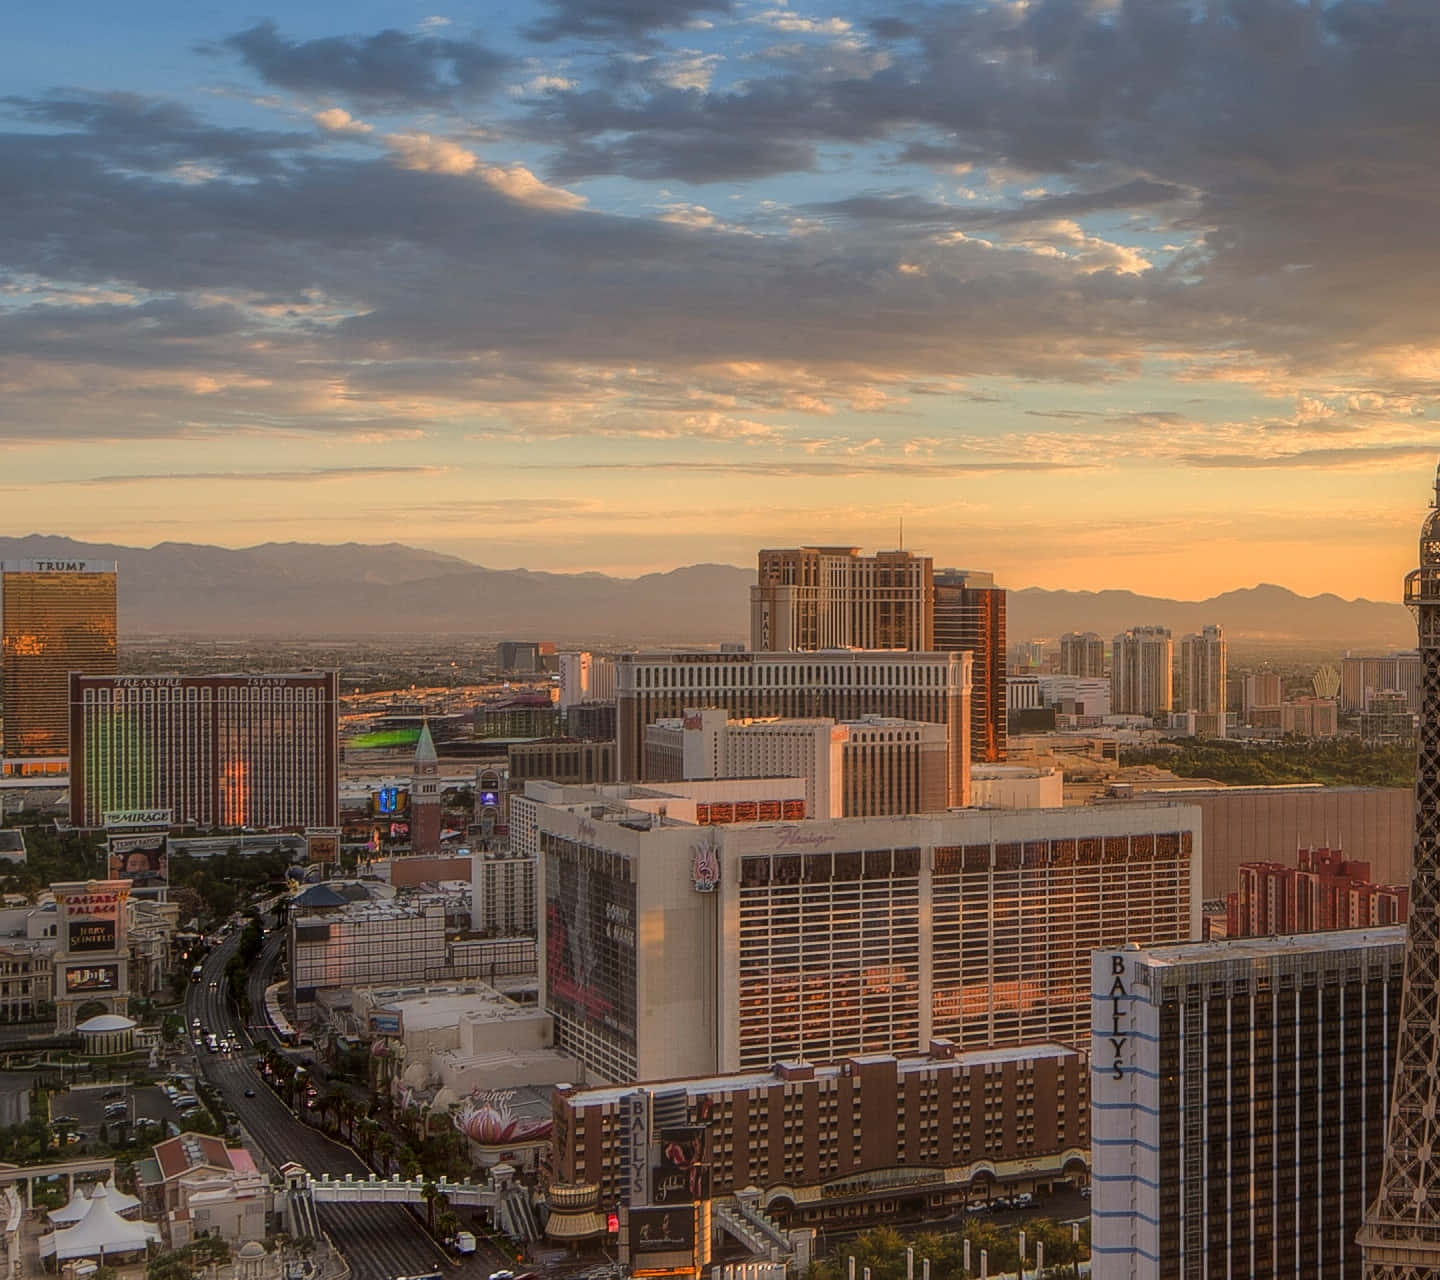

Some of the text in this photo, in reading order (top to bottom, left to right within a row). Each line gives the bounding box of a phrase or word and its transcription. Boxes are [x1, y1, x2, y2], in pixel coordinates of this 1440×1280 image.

[36, 561, 86, 571] TRUMP
[676, 654, 753, 663] VENETIAN
[114, 678, 287, 687] TREASURE ISLAND
[112, 812, 169, 823] MIRAGE
[65, 894, 117, 905] CAESARS
[67, 904, 115, 915] PALACE
